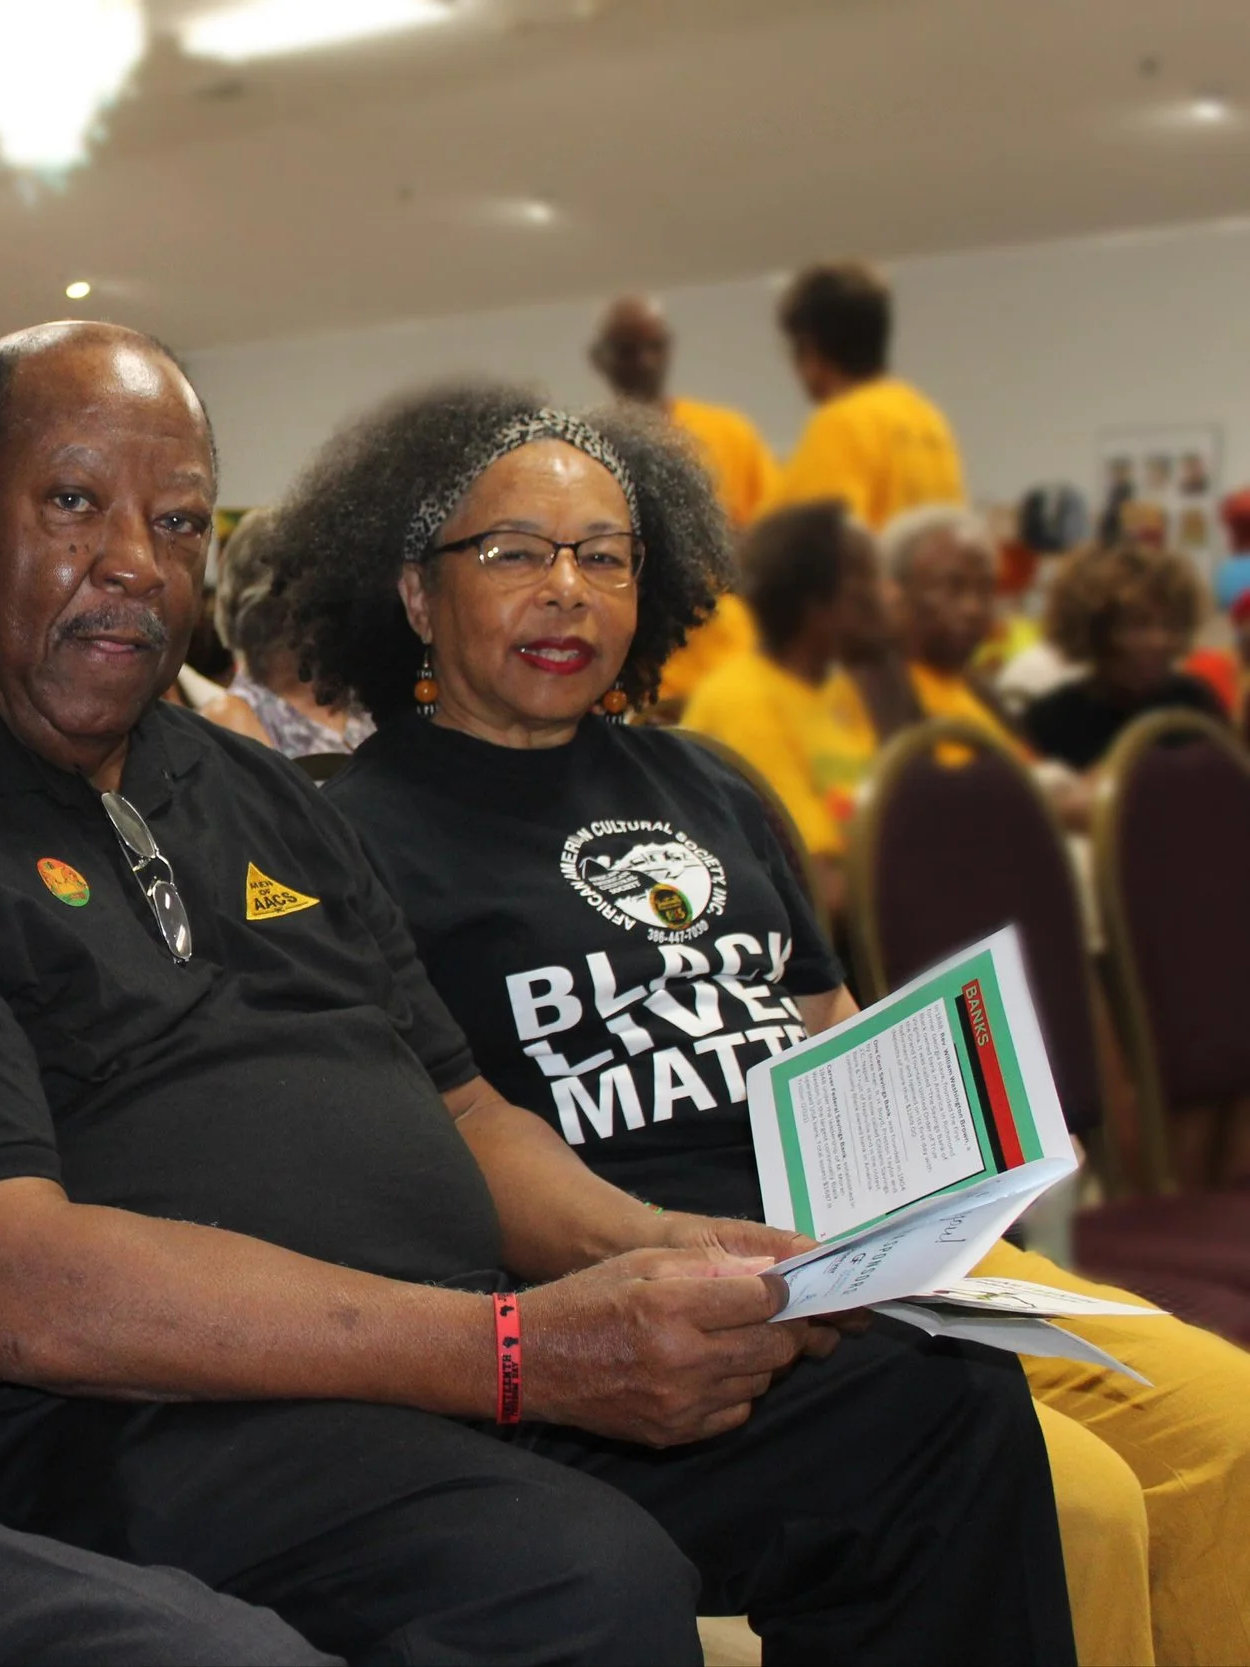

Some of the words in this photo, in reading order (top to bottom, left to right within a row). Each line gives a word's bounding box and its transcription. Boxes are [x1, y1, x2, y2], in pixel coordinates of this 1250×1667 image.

[590, 820, 673, 837] CULTURAL
[250, 881, 273, 889] MEN
[254, 892, 297, 911] AACS
[570, 879, 636, 931] AFRICAN
[647, 919, 710, 945] 386-447-7030
[505, 931, 793, 1042] BLACK
[965, 985, 989, 1046] BANKS
[871, 1038, 879, 1054] One
[929, 1031, 942, 1061] Georgia
[825, 1063, 834, 1087] Carver
[874, 1053, 883, 1072] Cent
[877, 1070, 888, 1100] Savings
[942, 1047, 954, 1076] William
[948, 1074, 964, 1119] Washington
[830, 1086, 839, 1114] Federal
[882, 1098, 892, 1120] Bank,
[933, 1081, 945, 1112] America
[941, 1080, 954, 1113] founded
[833, 1112, 844, 1142] Savings
[923, 1110, 933, 1133] Order
[929, 1104, 941, 1134] Savings
[949, 1112, 957, 1126] the
[936, 1132, 945, 1152] Bank
[952, 1125, 961, 1142] first
[940, 1150, 948, 1161] of
